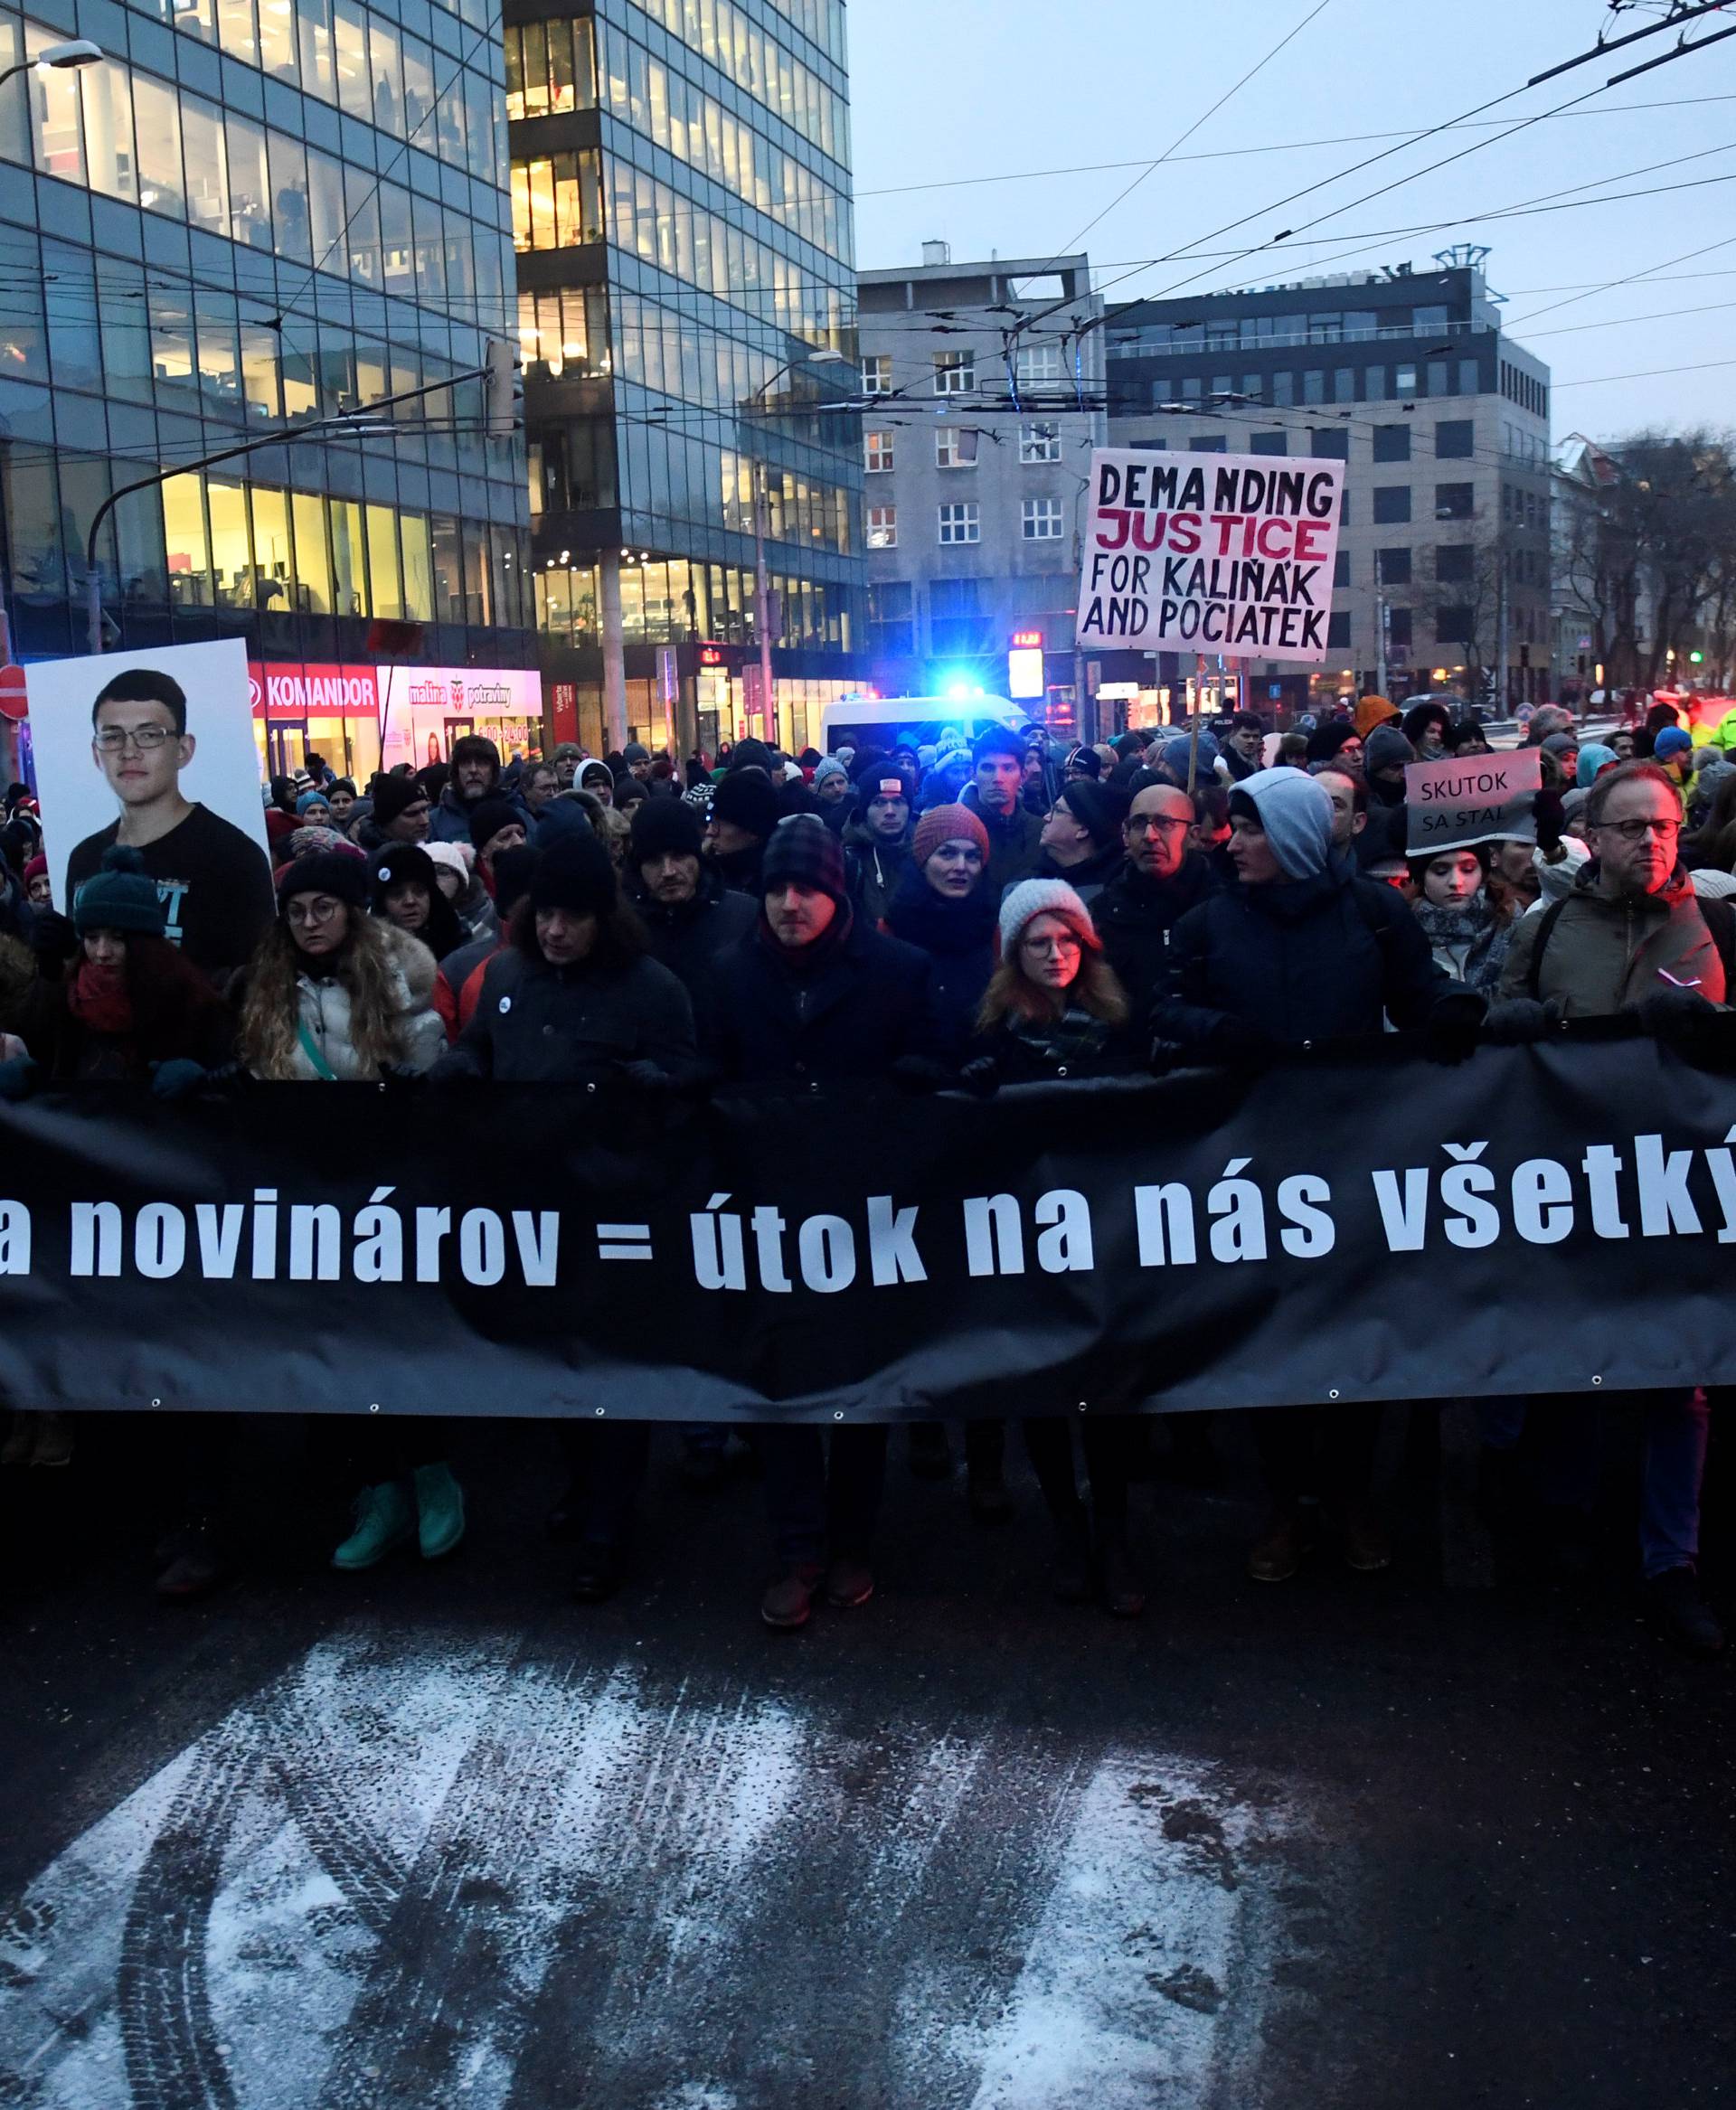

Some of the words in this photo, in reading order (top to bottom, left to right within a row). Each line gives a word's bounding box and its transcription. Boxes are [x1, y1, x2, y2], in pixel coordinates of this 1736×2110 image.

[1099, 464, 1334, 517] DEMANDING
[1096, 508, 1331, 561] JUSTICE
[1091, 553, 1150, 595] FOR
[1162, 557, 1321, 605] KALIŇÁK
[1081, 597, 1148, 636] AND
[1159, 598, 1326, 649] POČIATEK
[267, 676, 375, 707] KOMANDOR
[409, 681, 447, 704] malina
[467, 683, 511, 708] potraviny
[1421, 771, 1508, 801] SKUTOK
[1422, 815, 1448, 832] SA
[1456, 806, 1507, 827] STAL
[71, 1186, 559, 1286] novinárov
[597, 1223, 653, 1260] =
[690, 1192, 928, 1294] útok
[963, 1189, 1095, 1276] na
[1134, 1157, 1335, 1267] nás
